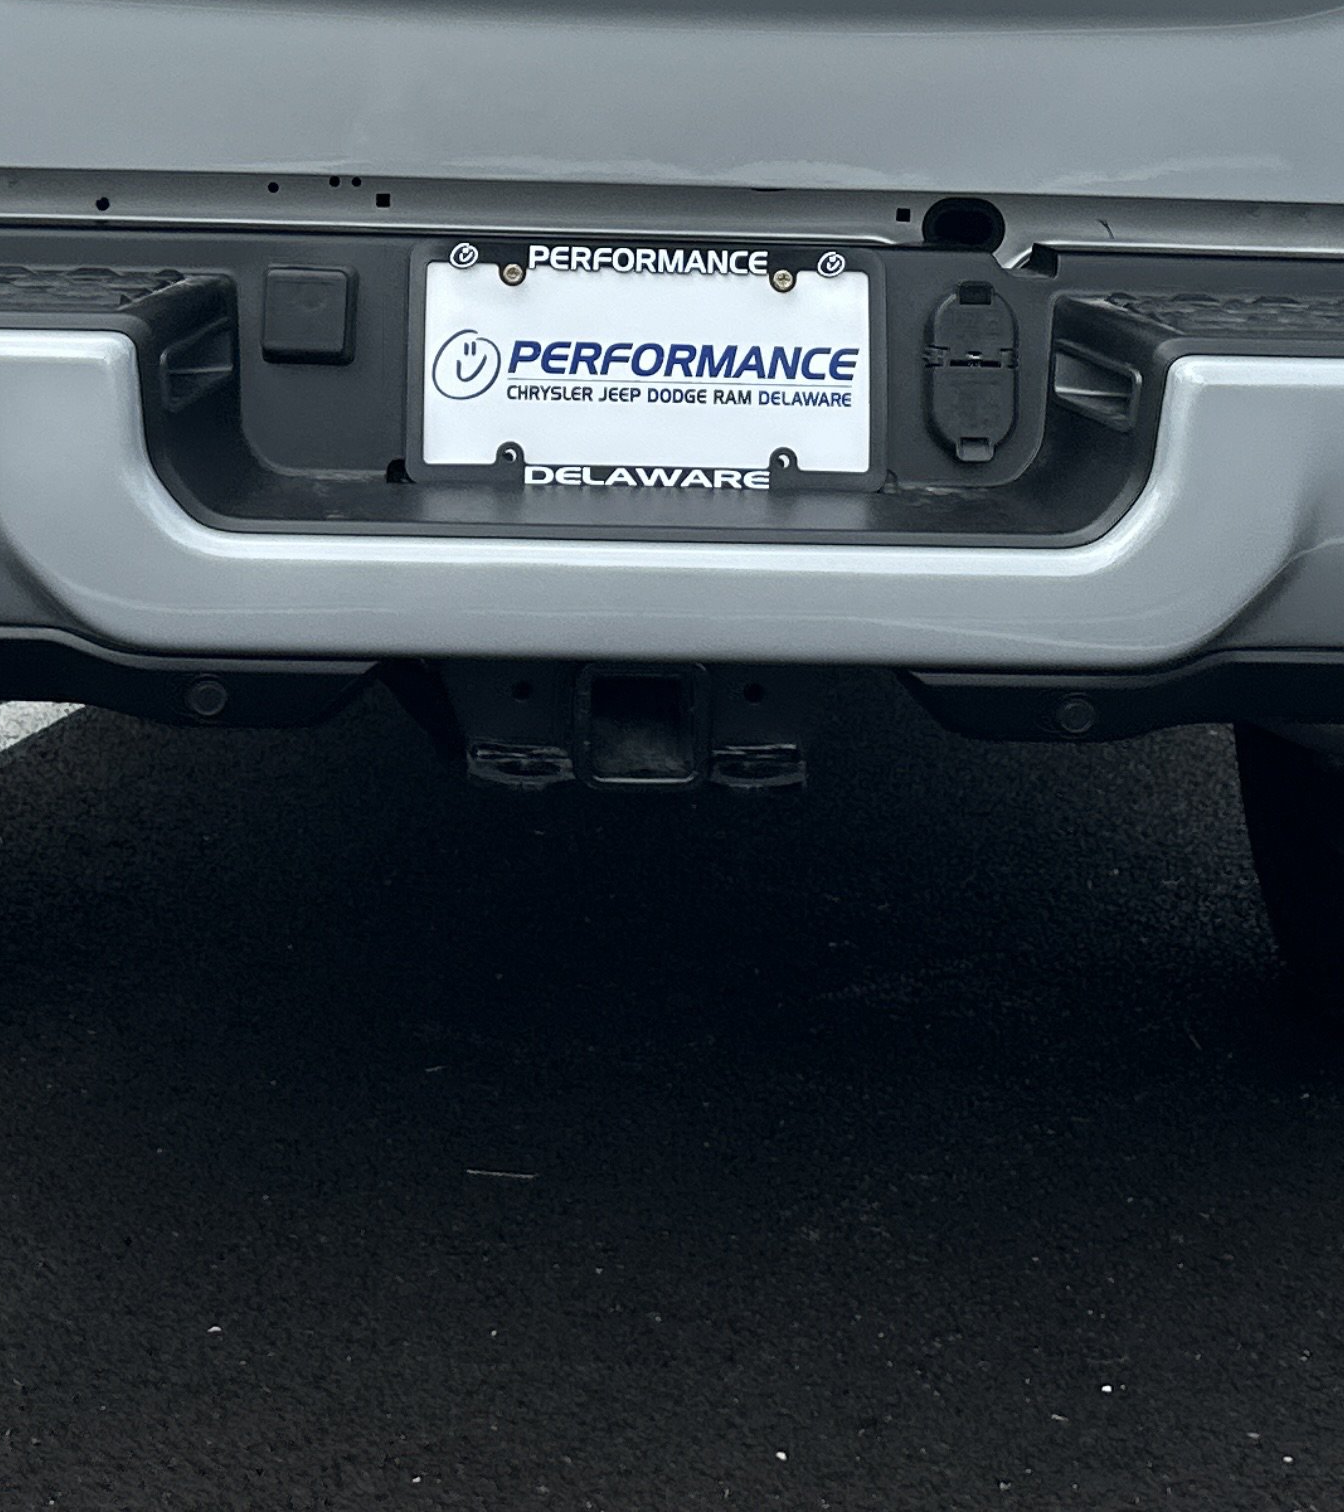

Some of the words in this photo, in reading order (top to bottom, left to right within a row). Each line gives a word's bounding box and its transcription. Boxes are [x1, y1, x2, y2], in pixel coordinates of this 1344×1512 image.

[529, 245, 768, 275] PERFORMANCE
[508, 341, 859, 381] PERFORMANCE
[507, 386, 593, 402] CHRYSLER
[598, 387, 641, 404] JEEP
[647, 389, 707, 404] DODGE
[713, 390, 752, 405] RAM
[758, 392, 852, 407] DELAWARE
[524, 466, 770, 489] DELAWARE
